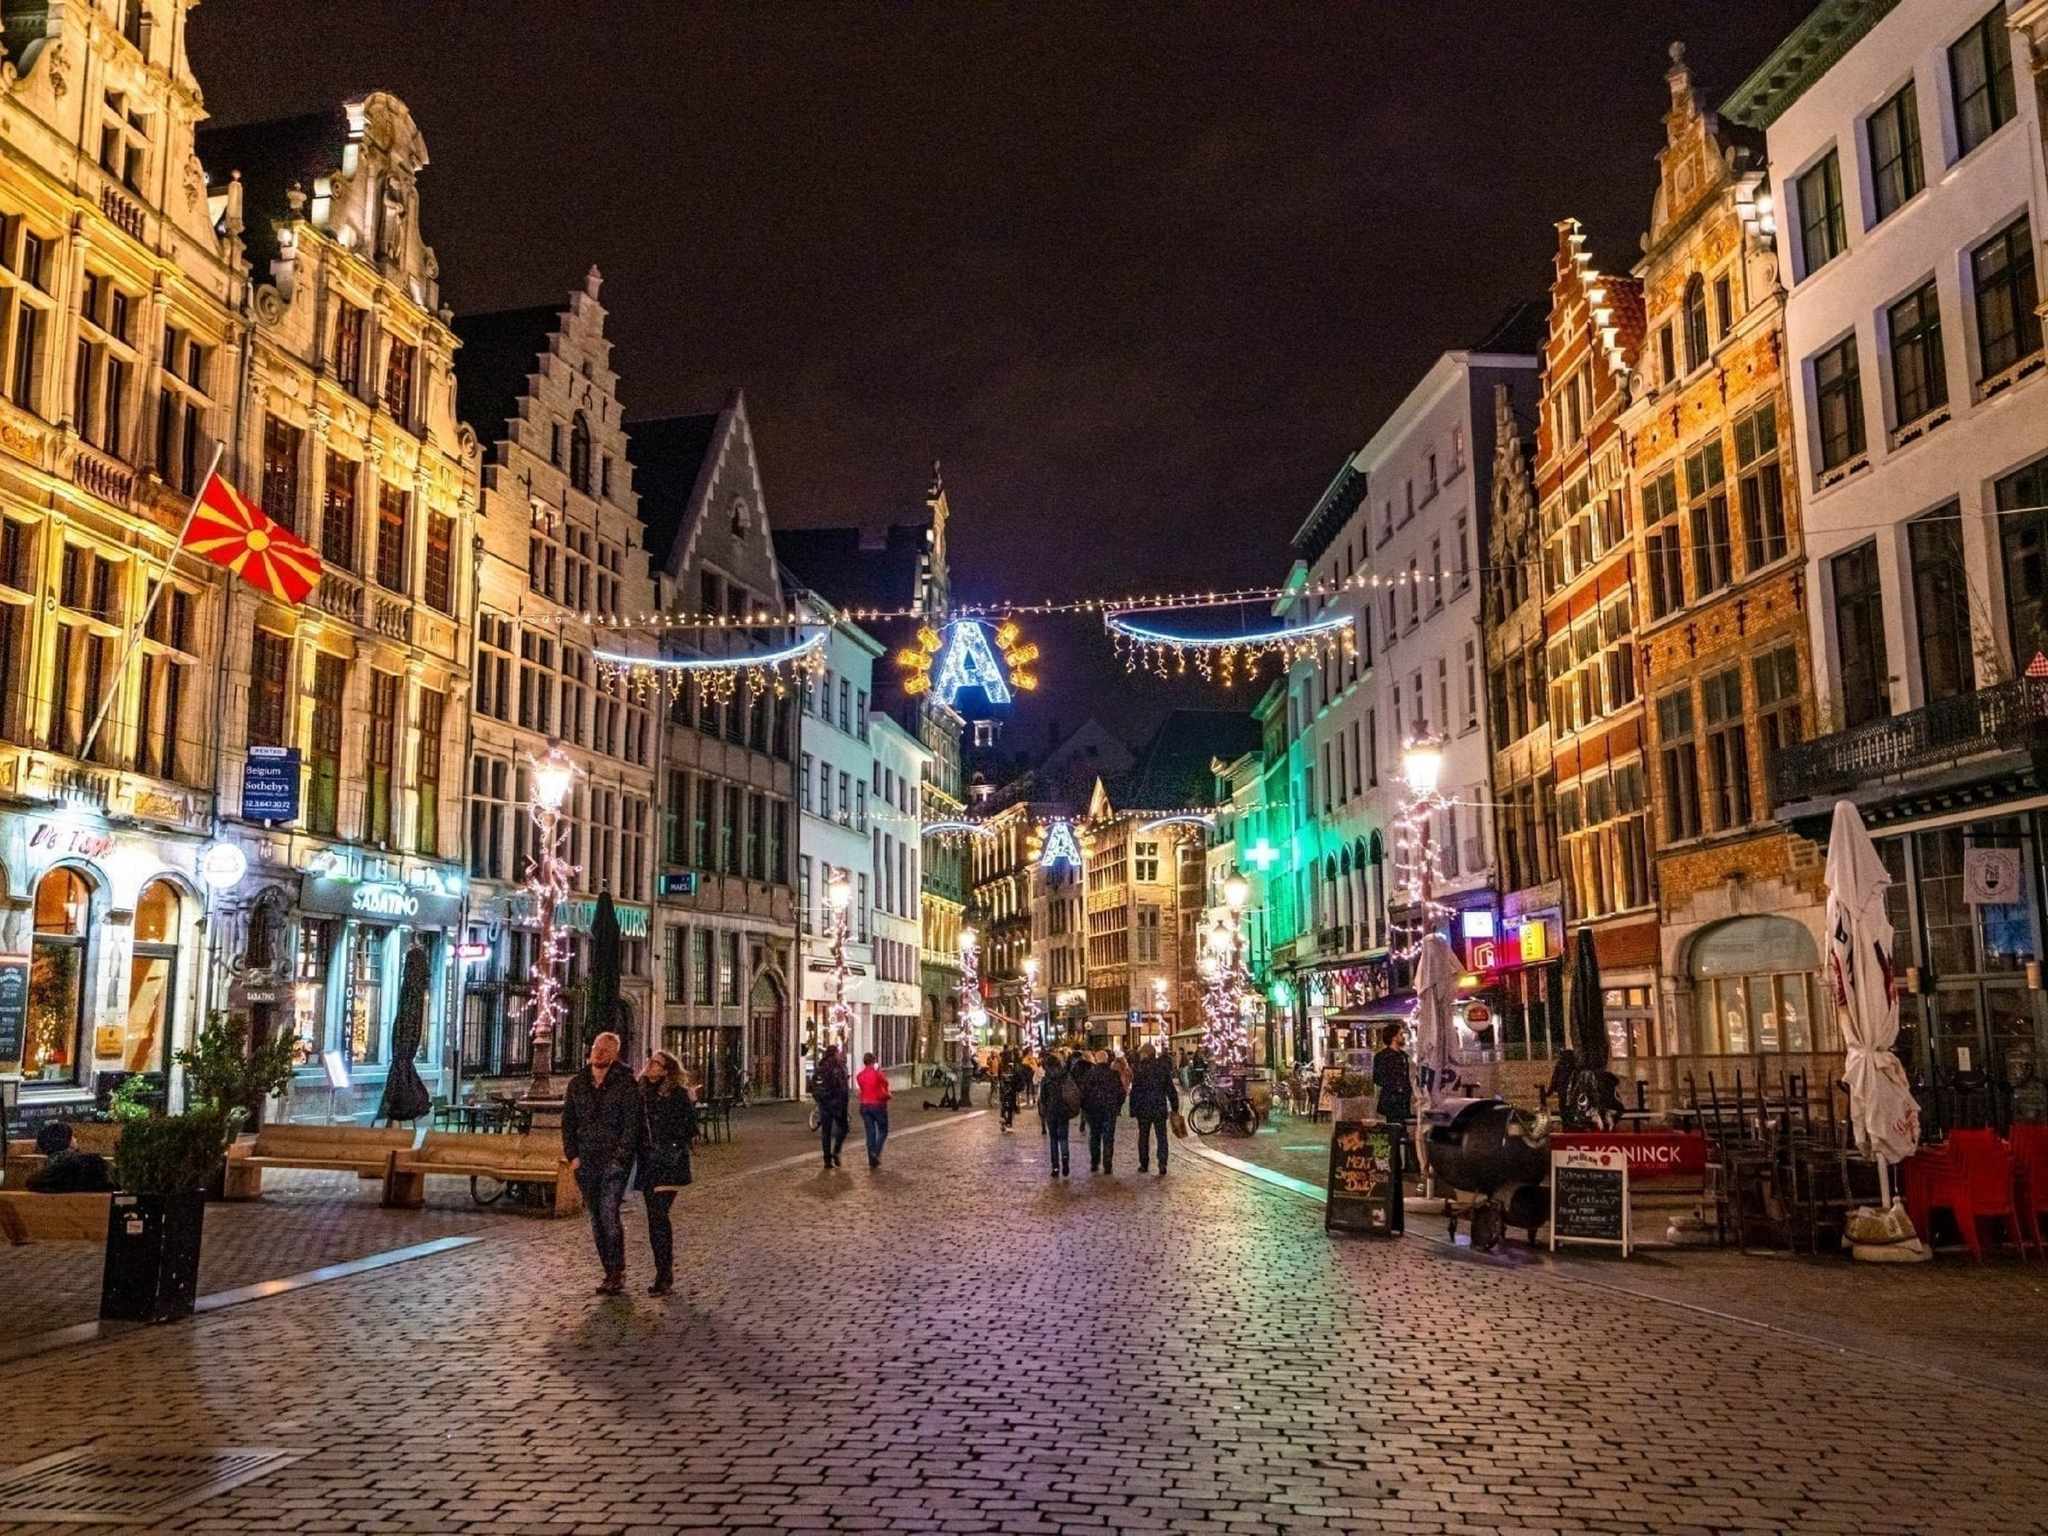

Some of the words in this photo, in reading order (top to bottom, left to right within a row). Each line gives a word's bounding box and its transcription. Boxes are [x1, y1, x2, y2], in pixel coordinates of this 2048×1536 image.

[935, 622, 1011, 704] A
[246, 766, 281, 776] Belgium
[344, 936, 356, 1061] RISTORANTE
